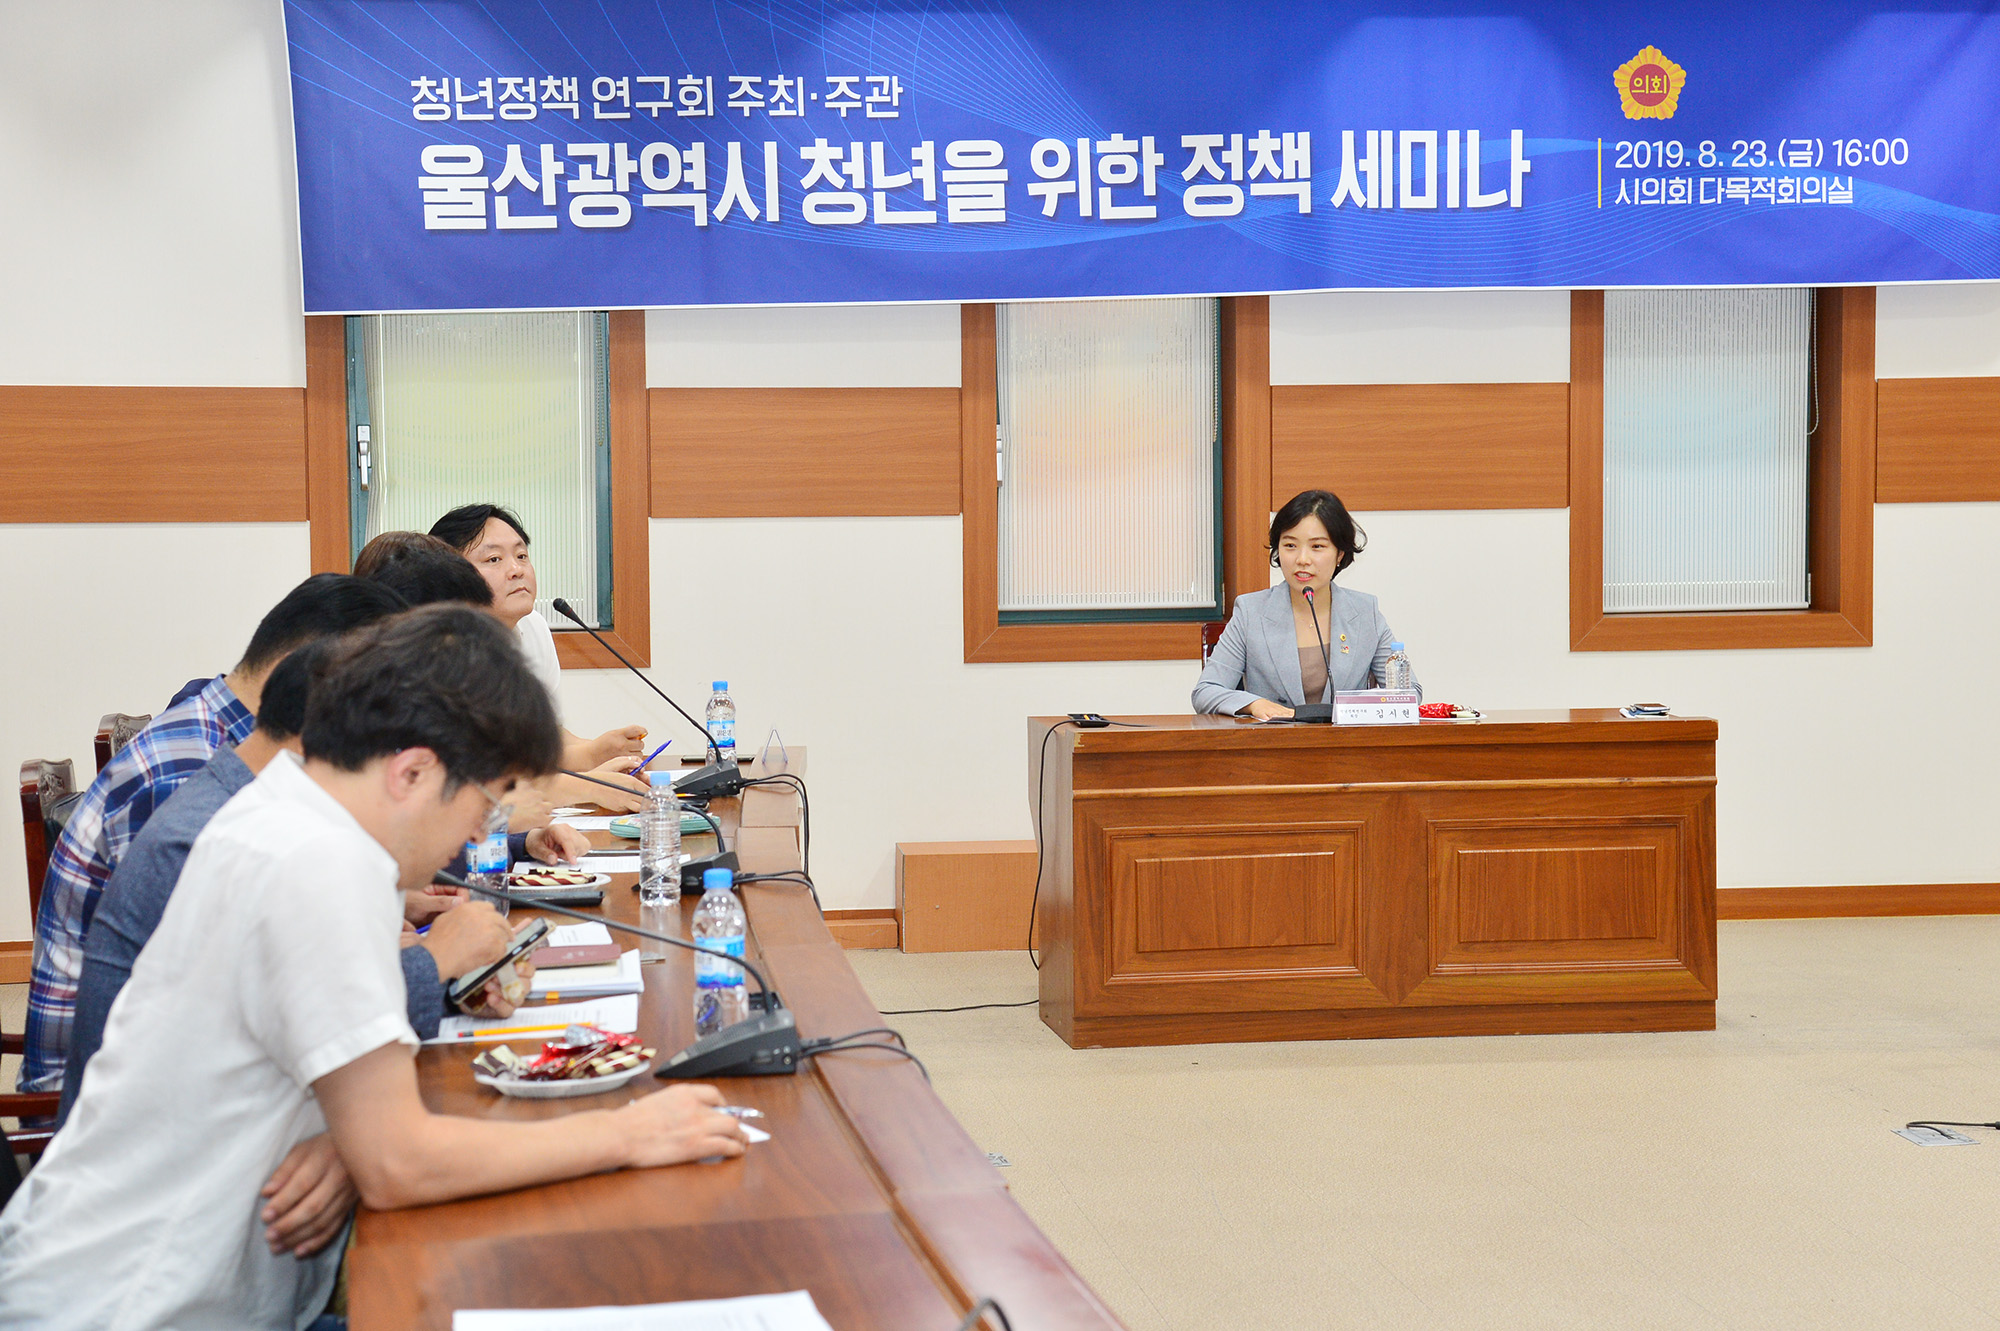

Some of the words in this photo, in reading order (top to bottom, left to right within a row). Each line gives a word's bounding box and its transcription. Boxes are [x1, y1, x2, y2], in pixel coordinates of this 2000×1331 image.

[410, 75, 580, 121] 청년정책
[592, 74, 714, 118] 연구회
[727, 74, 904, 118] 주최·주관
[1631, 74, 1667, 94] 의회
[1614, 140, 1691, 168] 2019.
[1698, 140, 1724, 168] 8.
[1832, 138, 1909, 167] 16:00
[417, 141, 780, 230] 울산광역시
[799, 137, 1009, 225] 청년을
[1026, 133, 1164, 220] 위한
[1181, 129, 1312, 217] 정책
[1330, 129, 1531, 209] 세미나
[1614, 177, 1693, 205] 시의회
[1700, 176, 1854, 205] 다목적회의실
